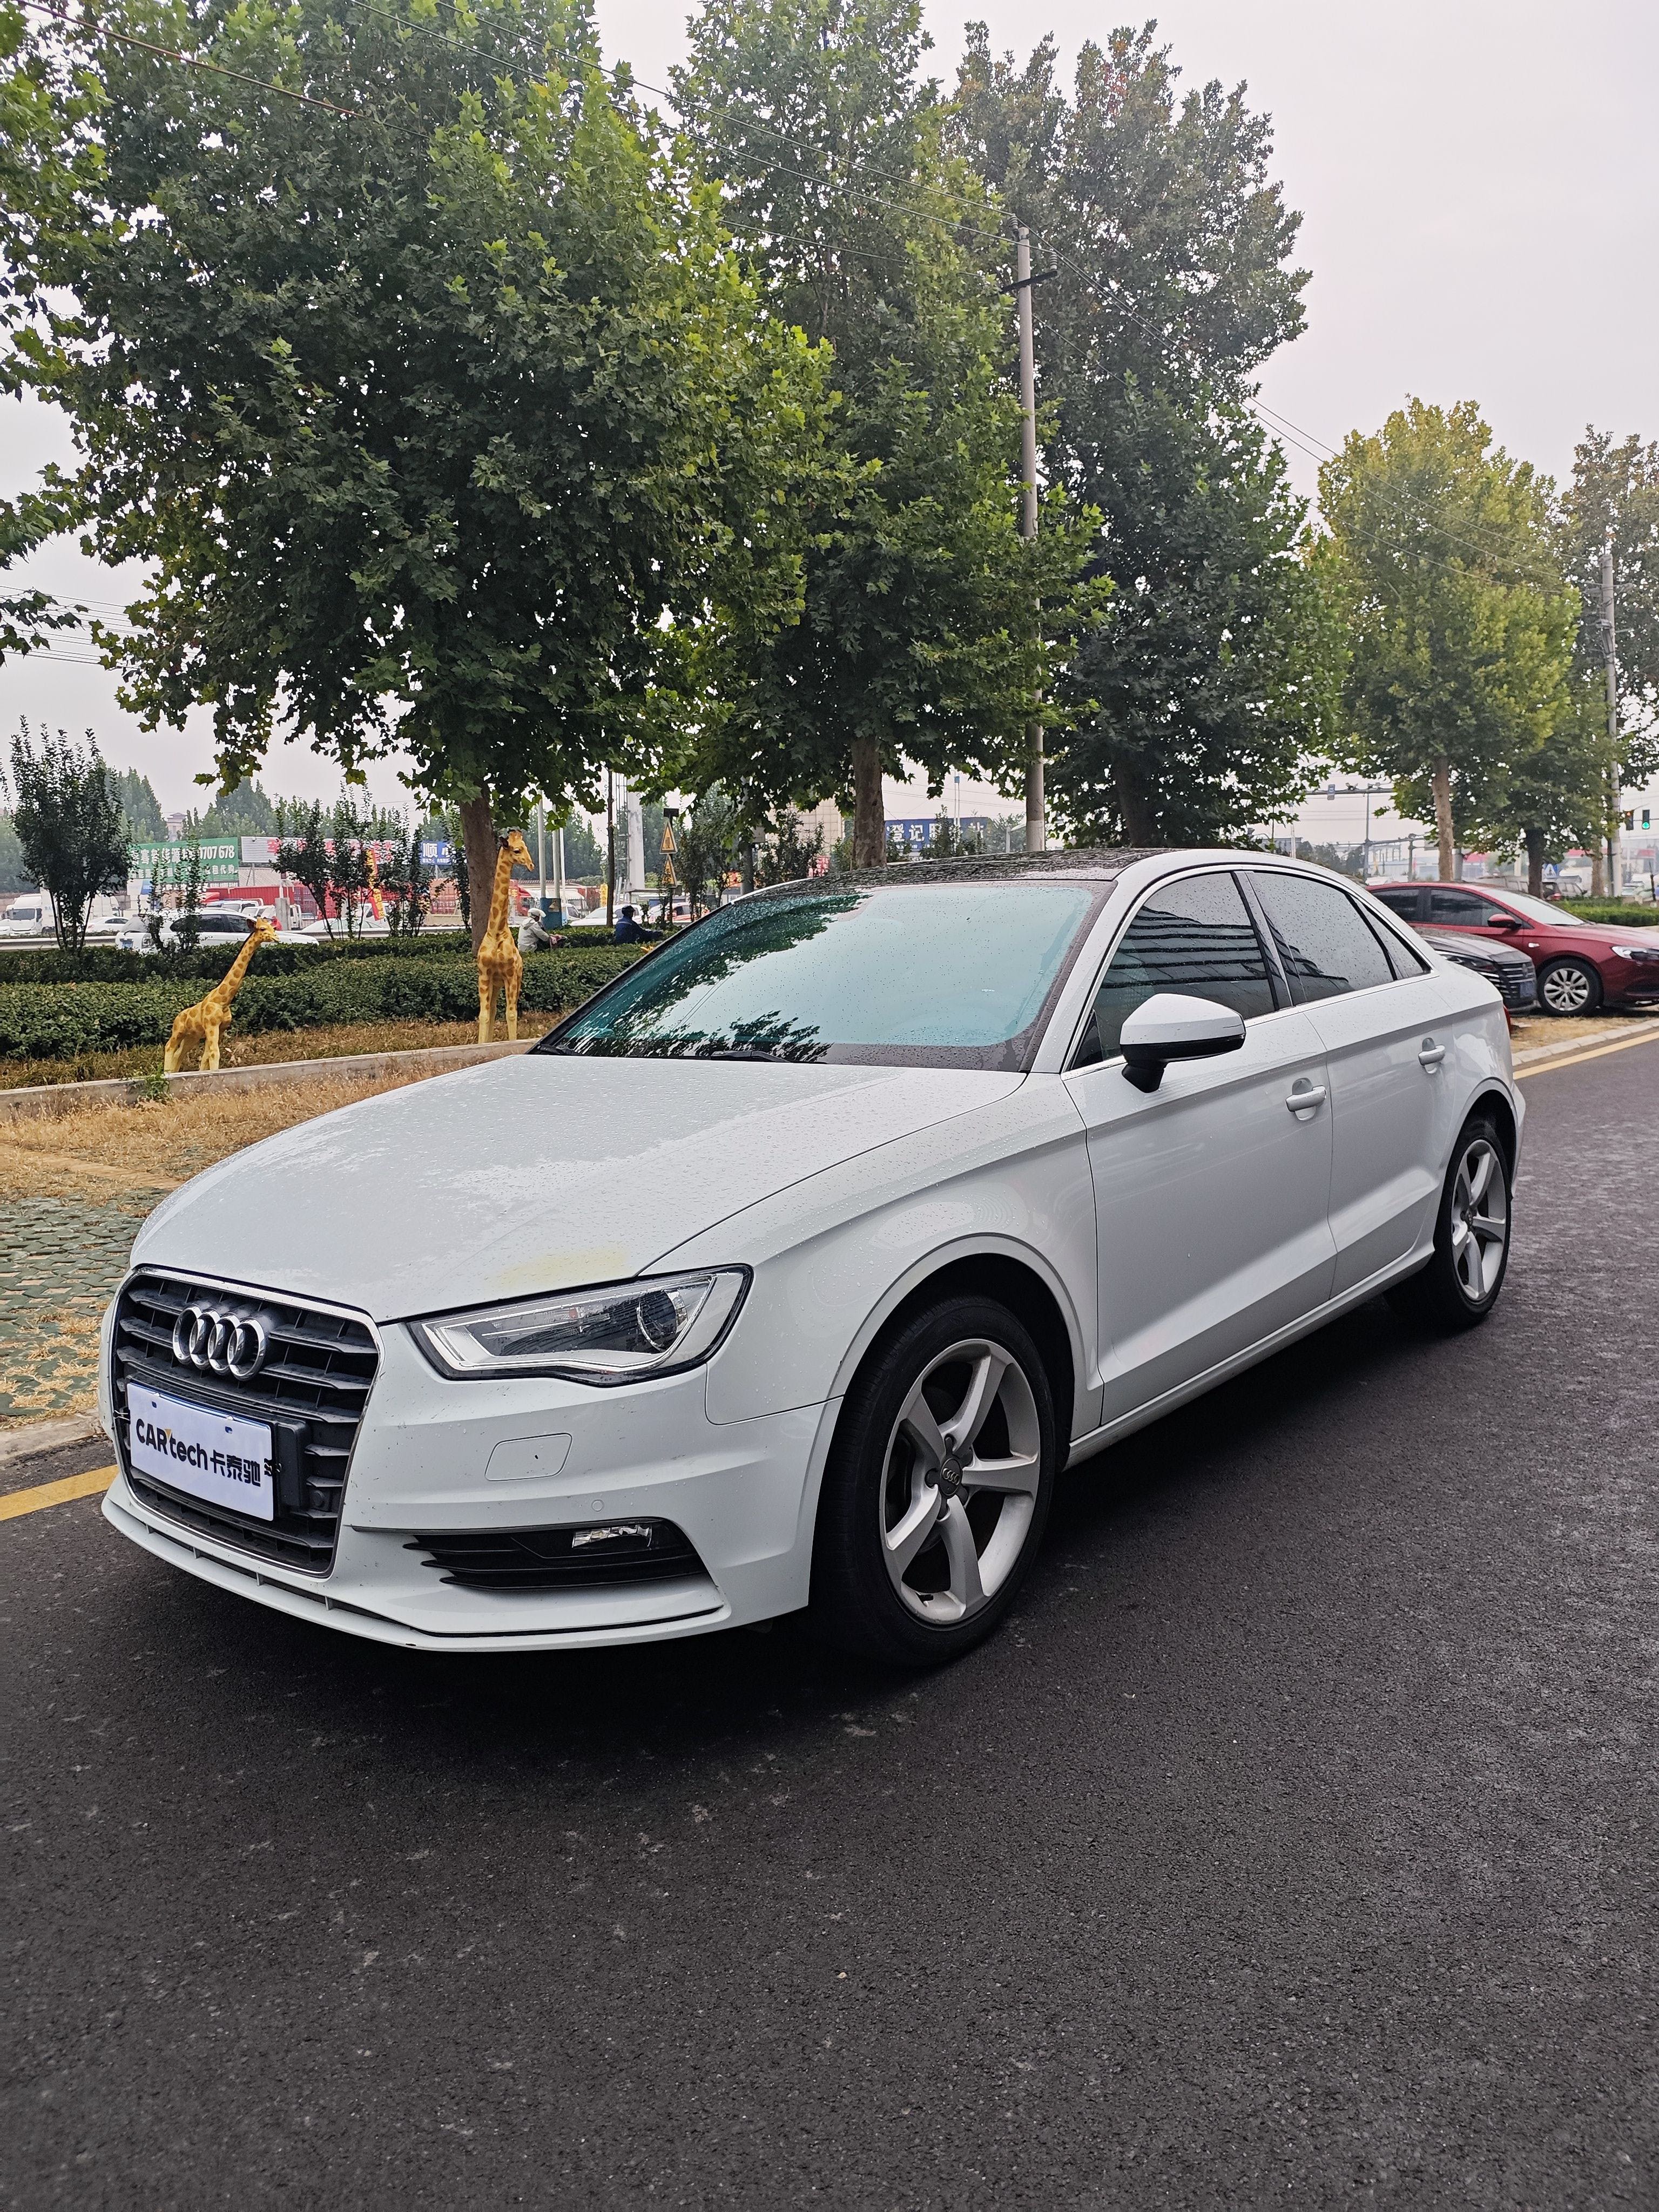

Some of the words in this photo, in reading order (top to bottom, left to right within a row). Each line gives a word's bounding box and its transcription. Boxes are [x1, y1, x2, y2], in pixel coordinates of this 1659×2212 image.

[136, 1418, 208, 1471] CARtech
[210, 1449, 261, 1487] 卡泰驰
